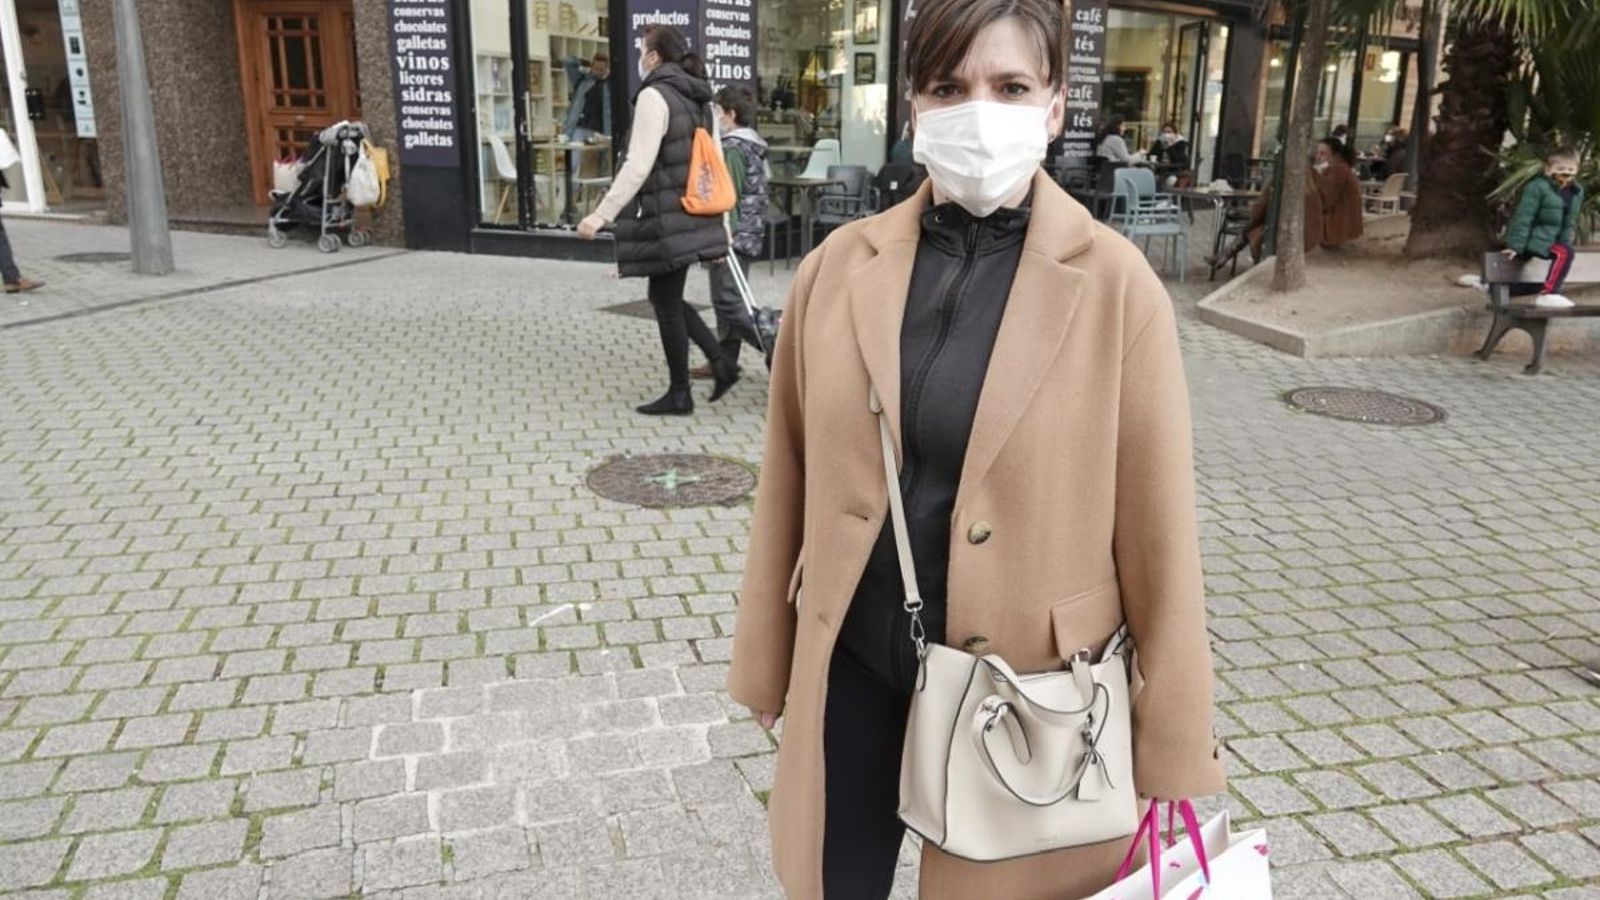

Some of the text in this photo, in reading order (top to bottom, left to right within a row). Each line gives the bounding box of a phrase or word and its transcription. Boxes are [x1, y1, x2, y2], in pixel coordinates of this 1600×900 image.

[632, 9, 690, 30] productos
[705, 8, 750, 23] conservas
[1075, 7, 1103, 23] café
[396, 35, 448, 54] galletas
[706, 40, 750, 60] galletas
[1074, 35, 1096, 52] tés
[395, 51, 450, 70] vinos
[704, 58, 752, 80] vinos
[399, 70, 445, 86] licores
[401, 86, 453, 104] sidras
[1067, 84, 1094, 100] café
[1073, 112, 1094, 128] tés
[404, 130, 454, 150] galletas
